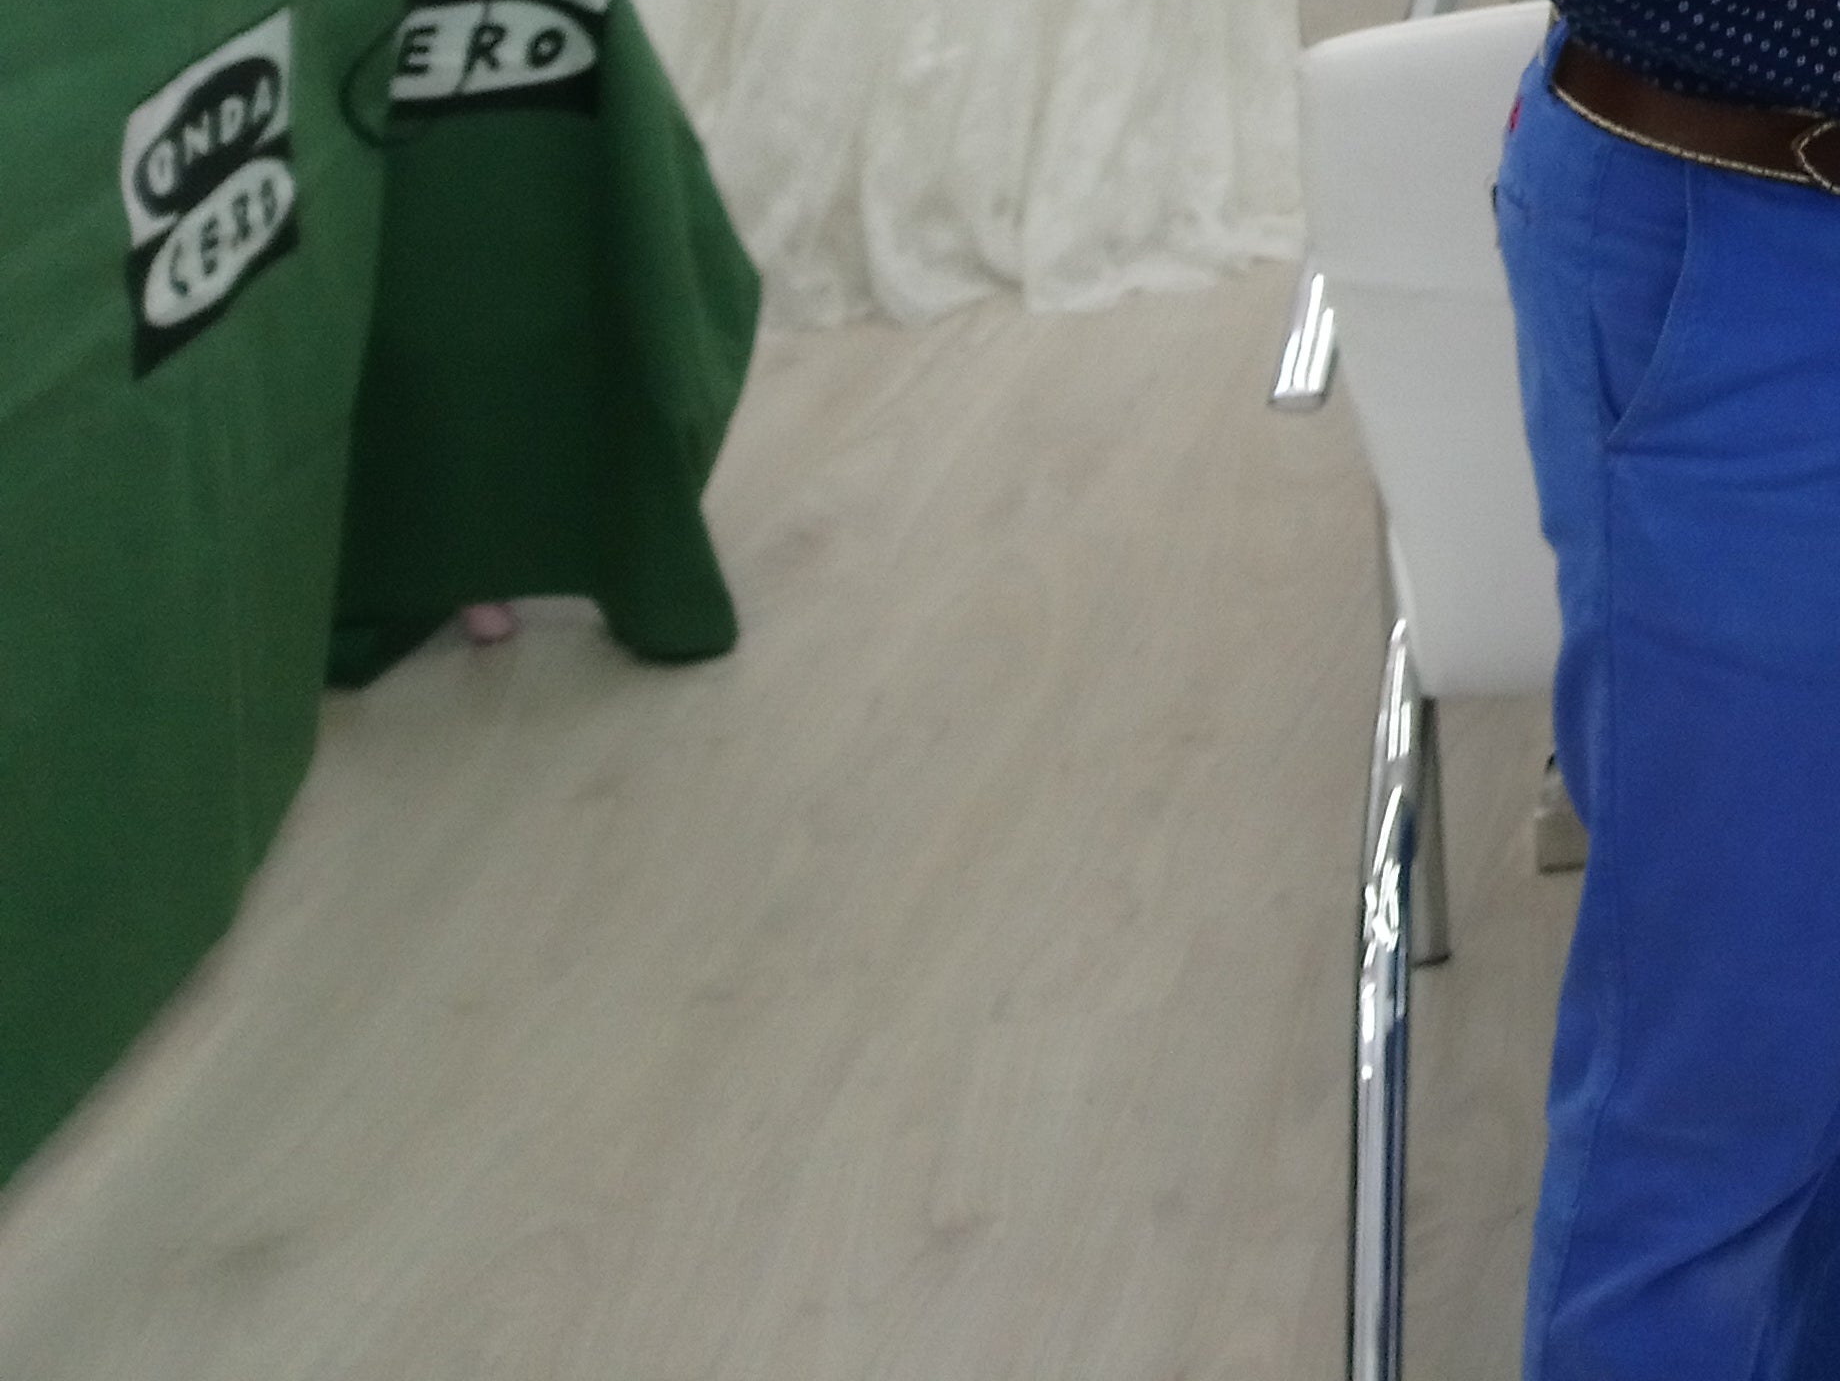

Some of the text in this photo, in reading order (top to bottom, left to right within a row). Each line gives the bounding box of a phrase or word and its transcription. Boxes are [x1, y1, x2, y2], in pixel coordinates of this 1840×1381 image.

[400, 24, 568, 77] ERO
[148, 75, 273, 197] ONDA
[167, 175, 279, 297] CERO
